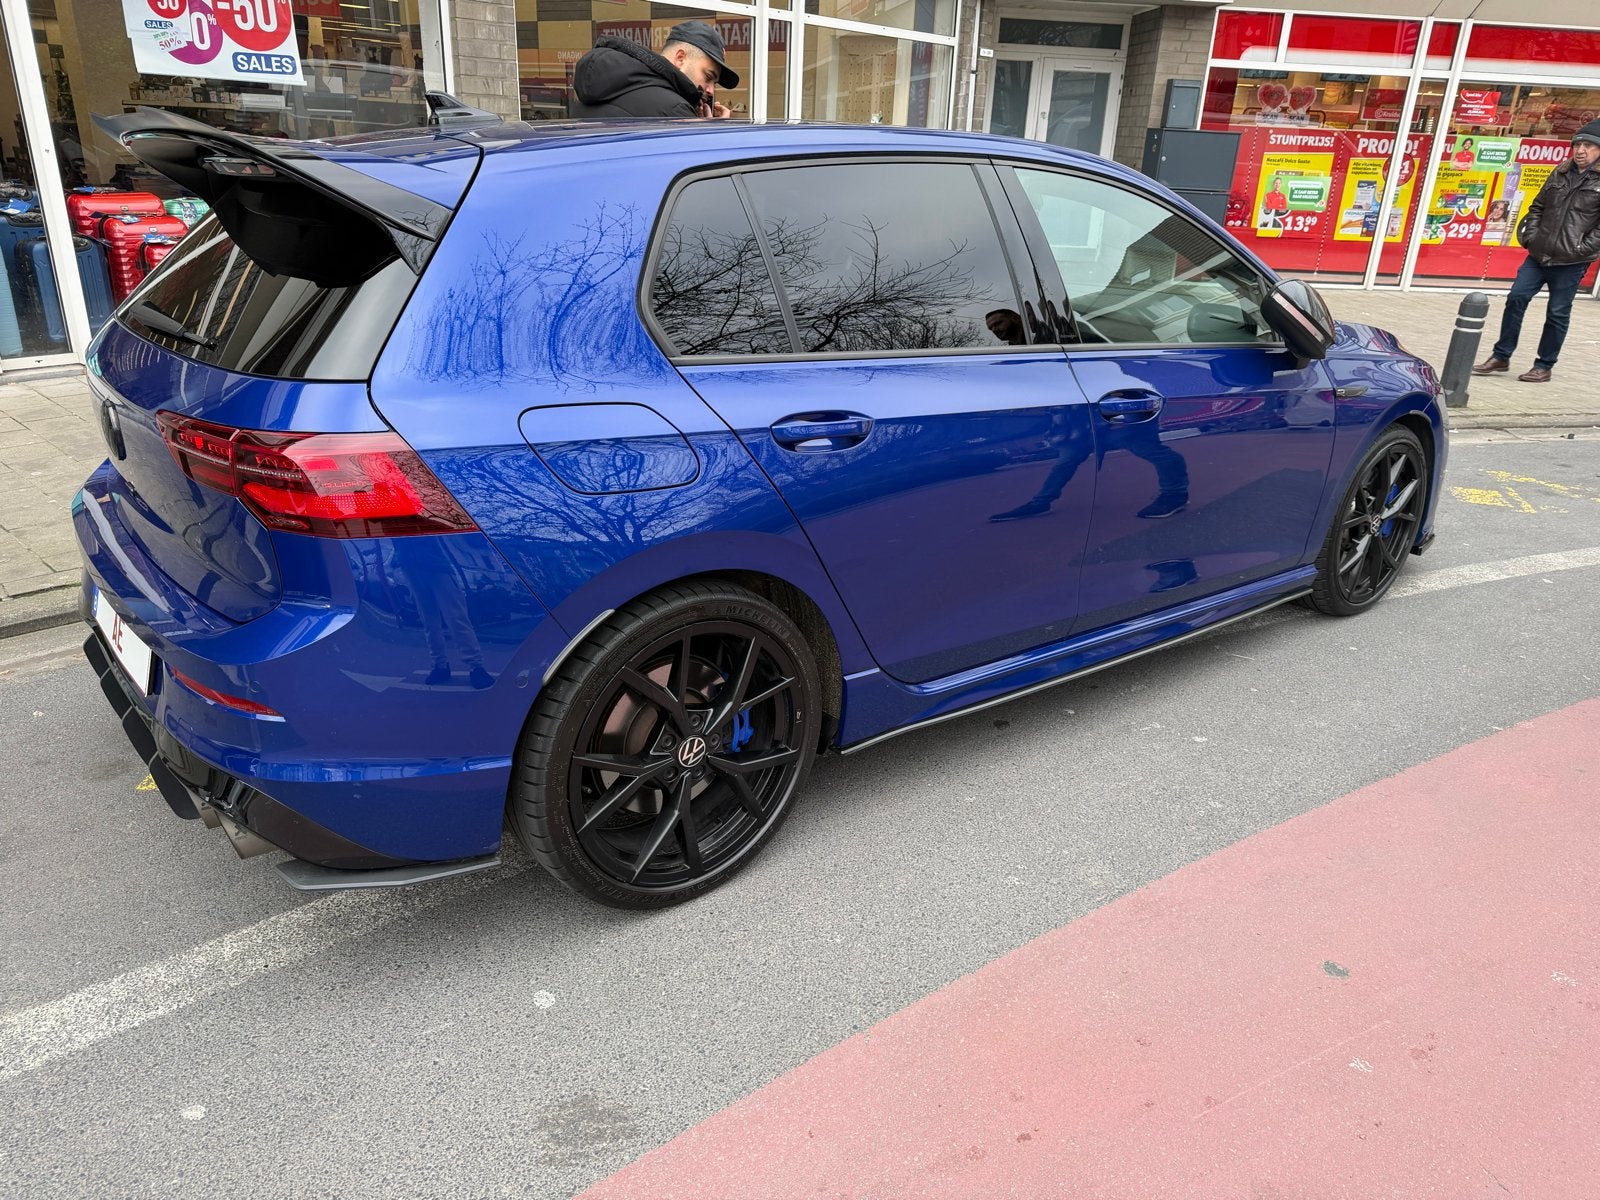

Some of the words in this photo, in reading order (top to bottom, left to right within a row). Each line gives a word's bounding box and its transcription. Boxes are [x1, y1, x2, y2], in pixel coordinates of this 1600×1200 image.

[145, 20, 173, 29] SALES
[216, 0, 286, 32] -50
[158, 37, 182, 51] 50%
[236, 54, 294, 73] SALES
[1269, 133, 1335, 148] STUNTPRIJS!
[1357, 137, 1420, 156] PROO!
[1517, 144, 1571, 162] ROMO!
[1284, 215, 1318, 233] 13.99
[1447, 222, 1482, 239] 29.99
[725, 605, 792, 640] MICHELIN
